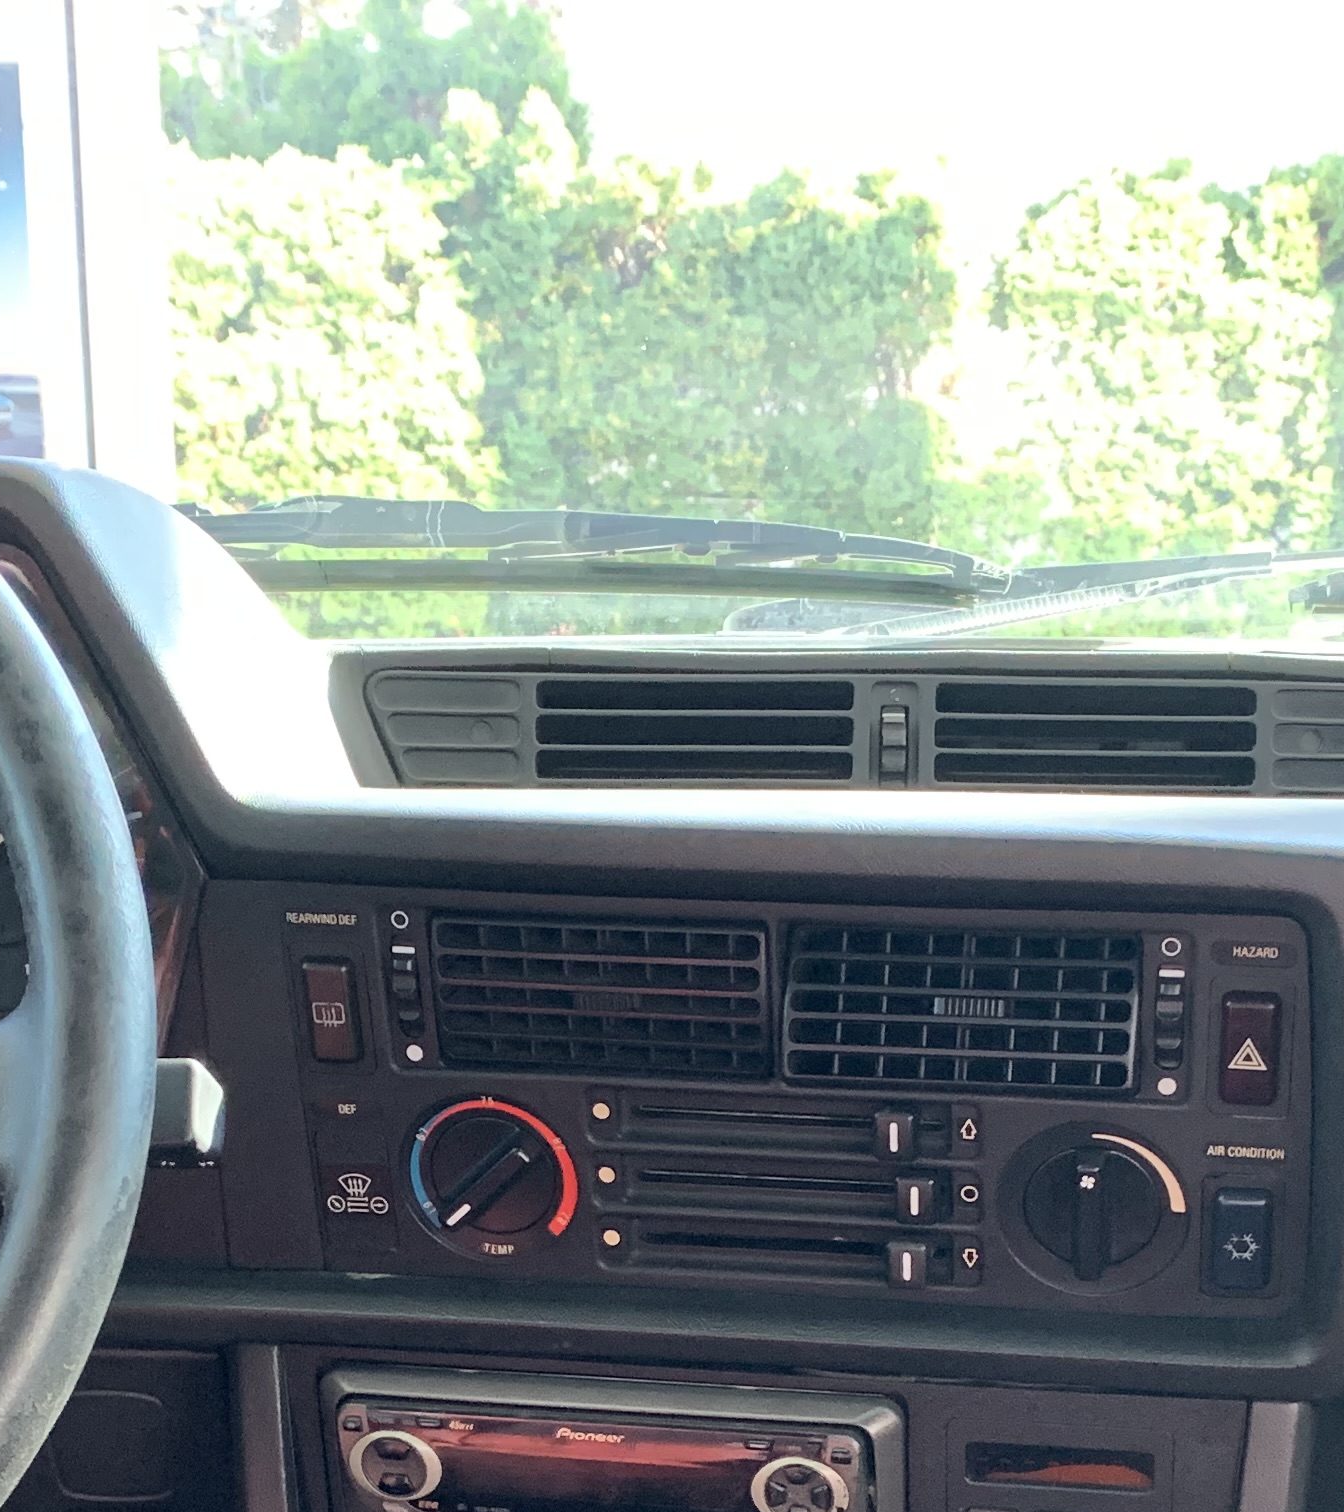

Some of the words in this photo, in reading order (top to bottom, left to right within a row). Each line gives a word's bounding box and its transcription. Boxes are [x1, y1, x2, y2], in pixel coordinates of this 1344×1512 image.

[1232, 946, 1279, 959] HAZARD
[337, 1103, 357, 1115] DEF
[1206, 1145, 1226, 1156] AIR
[1227, 1146, 1286, 1160] CONDITION
[483, 1243, 516, 1255] TEMP
[555, 1427, 626, 1445] Pioneer
